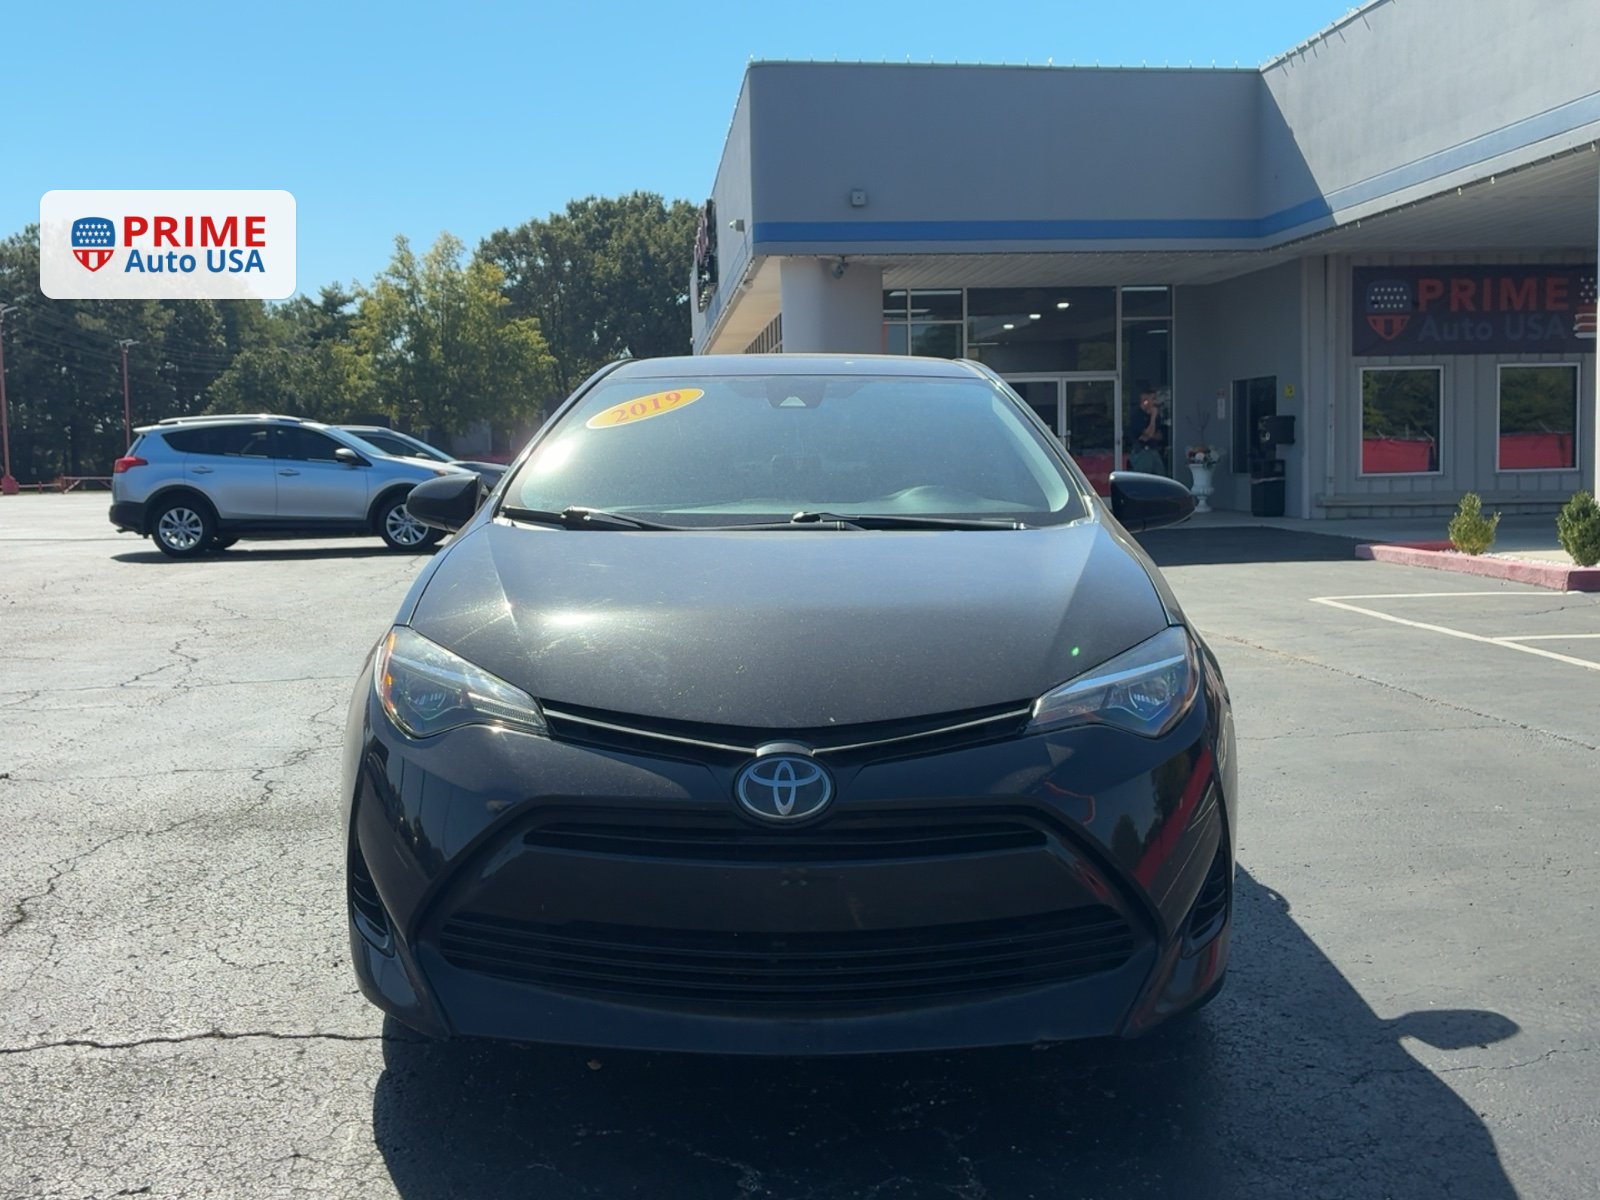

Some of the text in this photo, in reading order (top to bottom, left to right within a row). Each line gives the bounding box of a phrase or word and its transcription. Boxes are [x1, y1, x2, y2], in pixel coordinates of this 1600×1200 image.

[1417, 277, 1570, 312] PRIME
[1418, 314, 1568, 341] Auto USA
[611, 392, 682, 423] 2019
